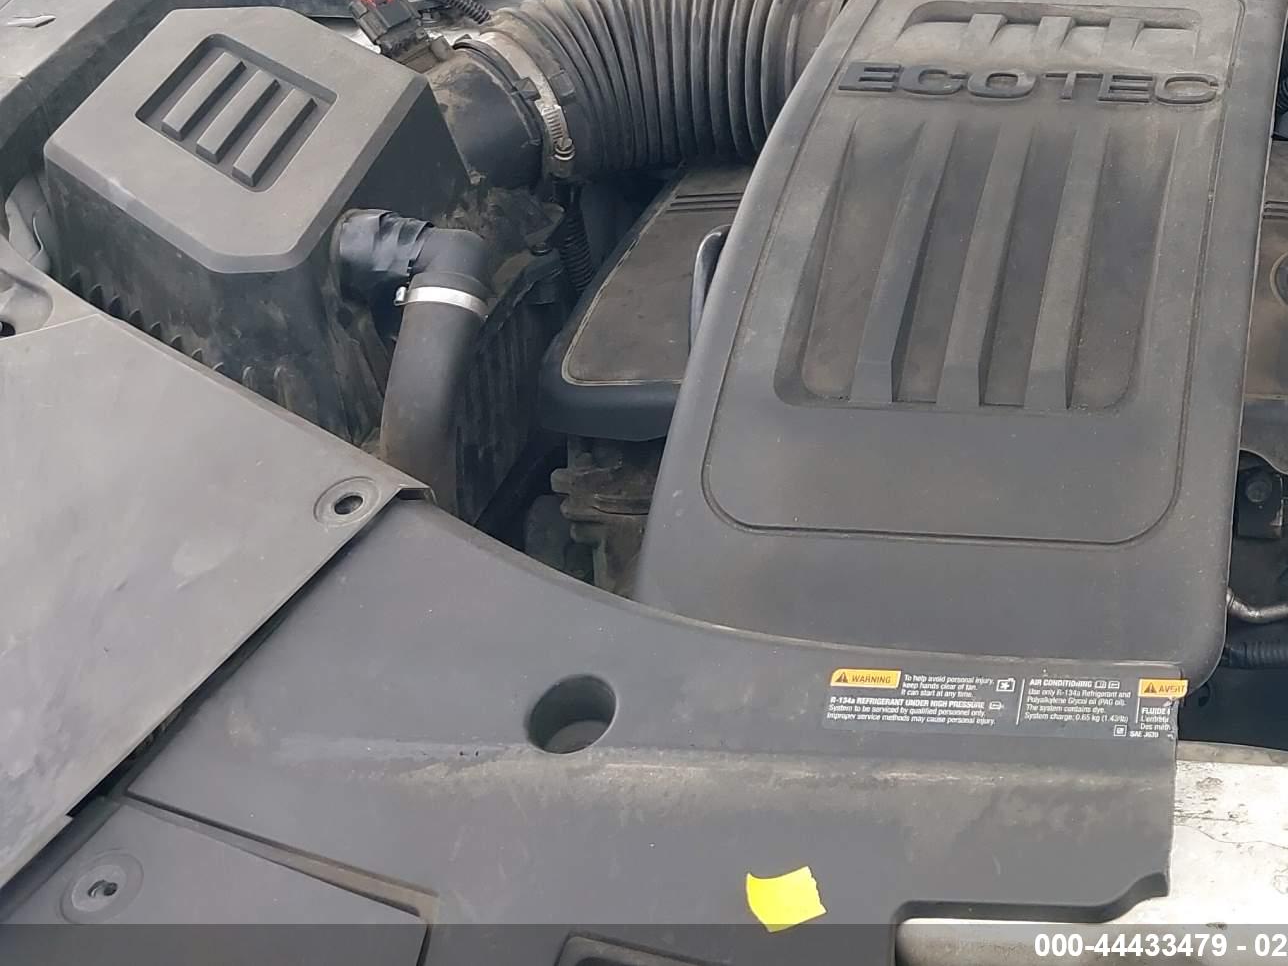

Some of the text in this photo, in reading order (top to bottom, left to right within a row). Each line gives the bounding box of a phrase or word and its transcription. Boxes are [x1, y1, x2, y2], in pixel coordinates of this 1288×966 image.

[837, 61, 1220, 106] ECOTEC
[852, 674, 891, 684] WARNING
[904, 674, 912, 682] To
[912, 674, 928, 684] help
[928, 675, 946, 683] avoid
[946, 676, 975, 685] personal
[1043, 679, 1092, 688] CONDITIONING
[920, 682, 940, 690] hands
[944, 691, 957, 699] any
[1042, 689, 1056, 697] only
[1082, 690, 1118, 698] Refrigerant
[1118, 690, 1132, 698] and
[856, 698, 904, 706] REFRIGERANT
[905, 699, 930, 707] UNDER
[930, 700, 948, 708] HIGH
[948, 700, 986, 709] PRESSURE
[1068, 698, 1088, 706] Glycol
[1098, 698, 1114, 707] (PAG
[828, 704, 852, 713] System
[900, 707, 908, 715] by
[908, 708, 937, 716] qualified
[938, 708, 970, 716] personnel
[1039, 704, 1062, 713] system
[826, 712, 856, 721] Improper
[882, 714, 910, 722] methods
[911, 716, 926, 724] may
[946, 716, 976, 725] personal
[1024, 712, 1048, 721] System
[1091, 714, 1101, 723] kg
[1130, 730, 1142, 738] SAE
